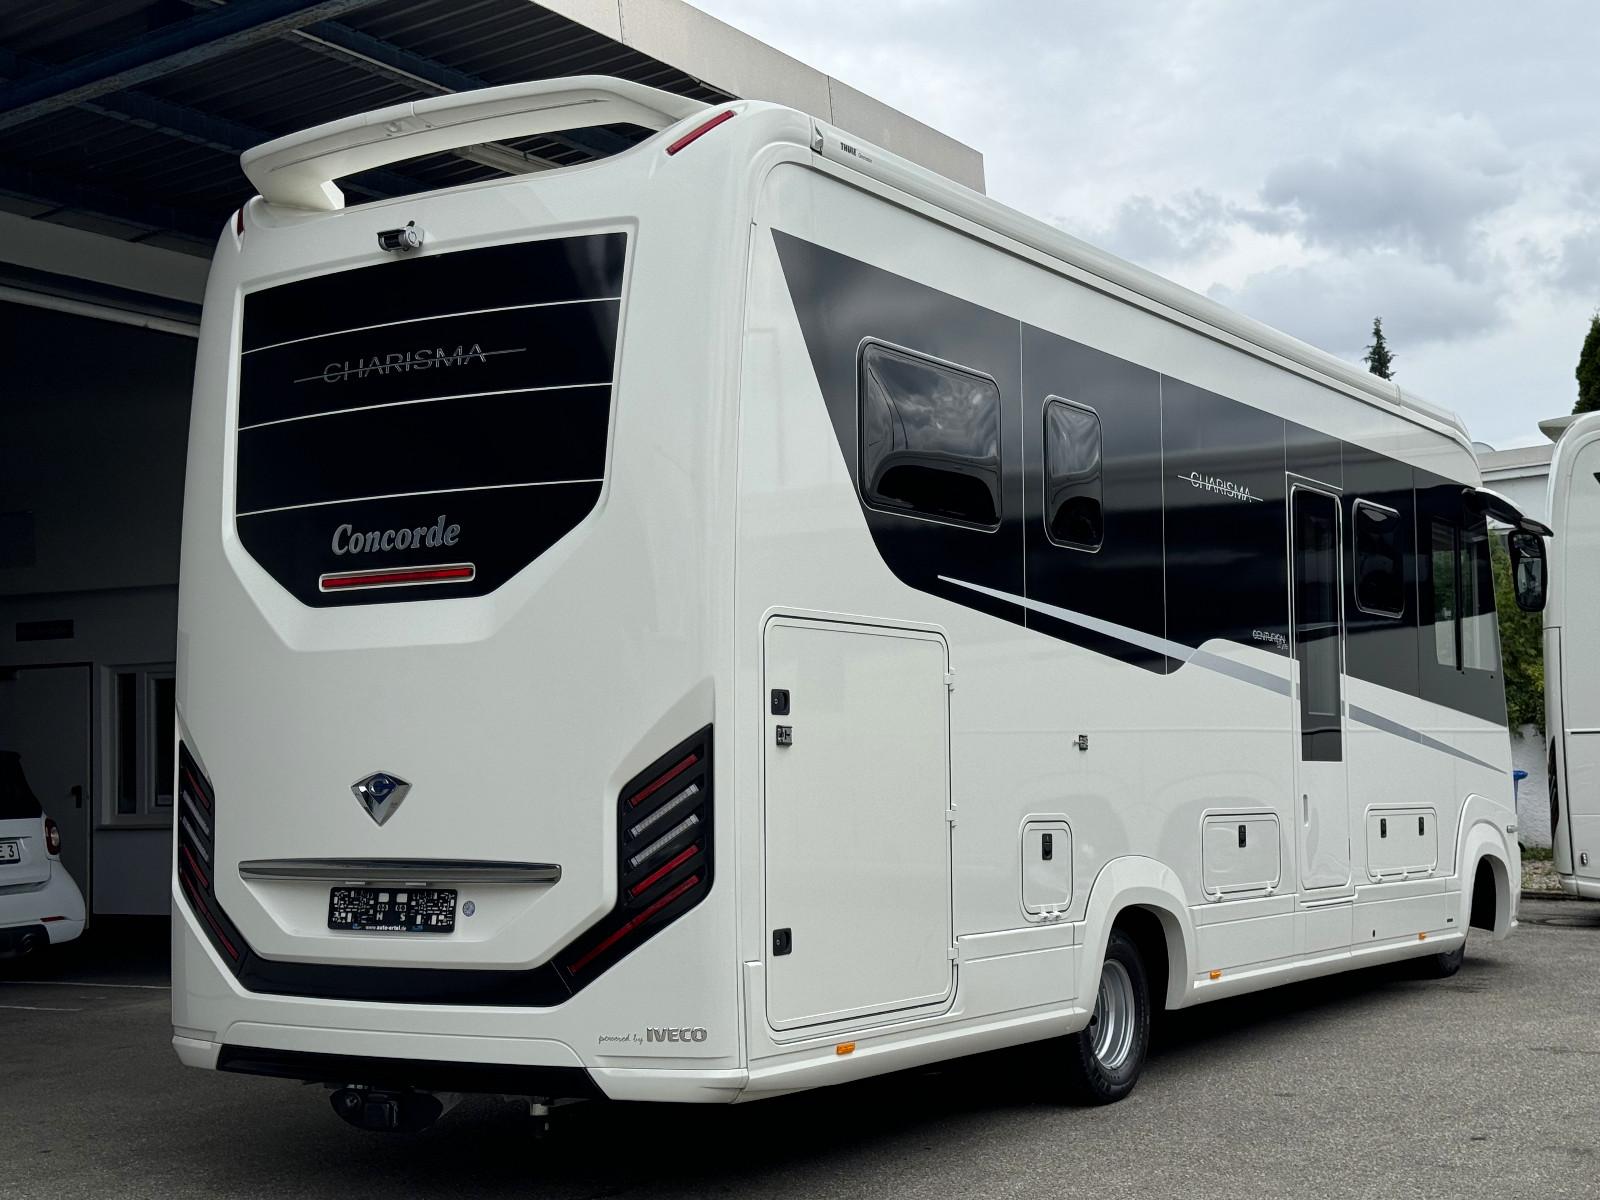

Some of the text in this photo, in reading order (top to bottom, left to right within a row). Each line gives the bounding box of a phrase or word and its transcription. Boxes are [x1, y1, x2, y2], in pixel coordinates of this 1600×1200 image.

[840, 142, 857, 157] THULE
[323, 343, 487, 383] CHARISMA
[1190, 471, 1252, 503] CHARISMA
[331, 514, 461, 556] Concorde
[598, 1026, 708, 1046] powered by IVECO
